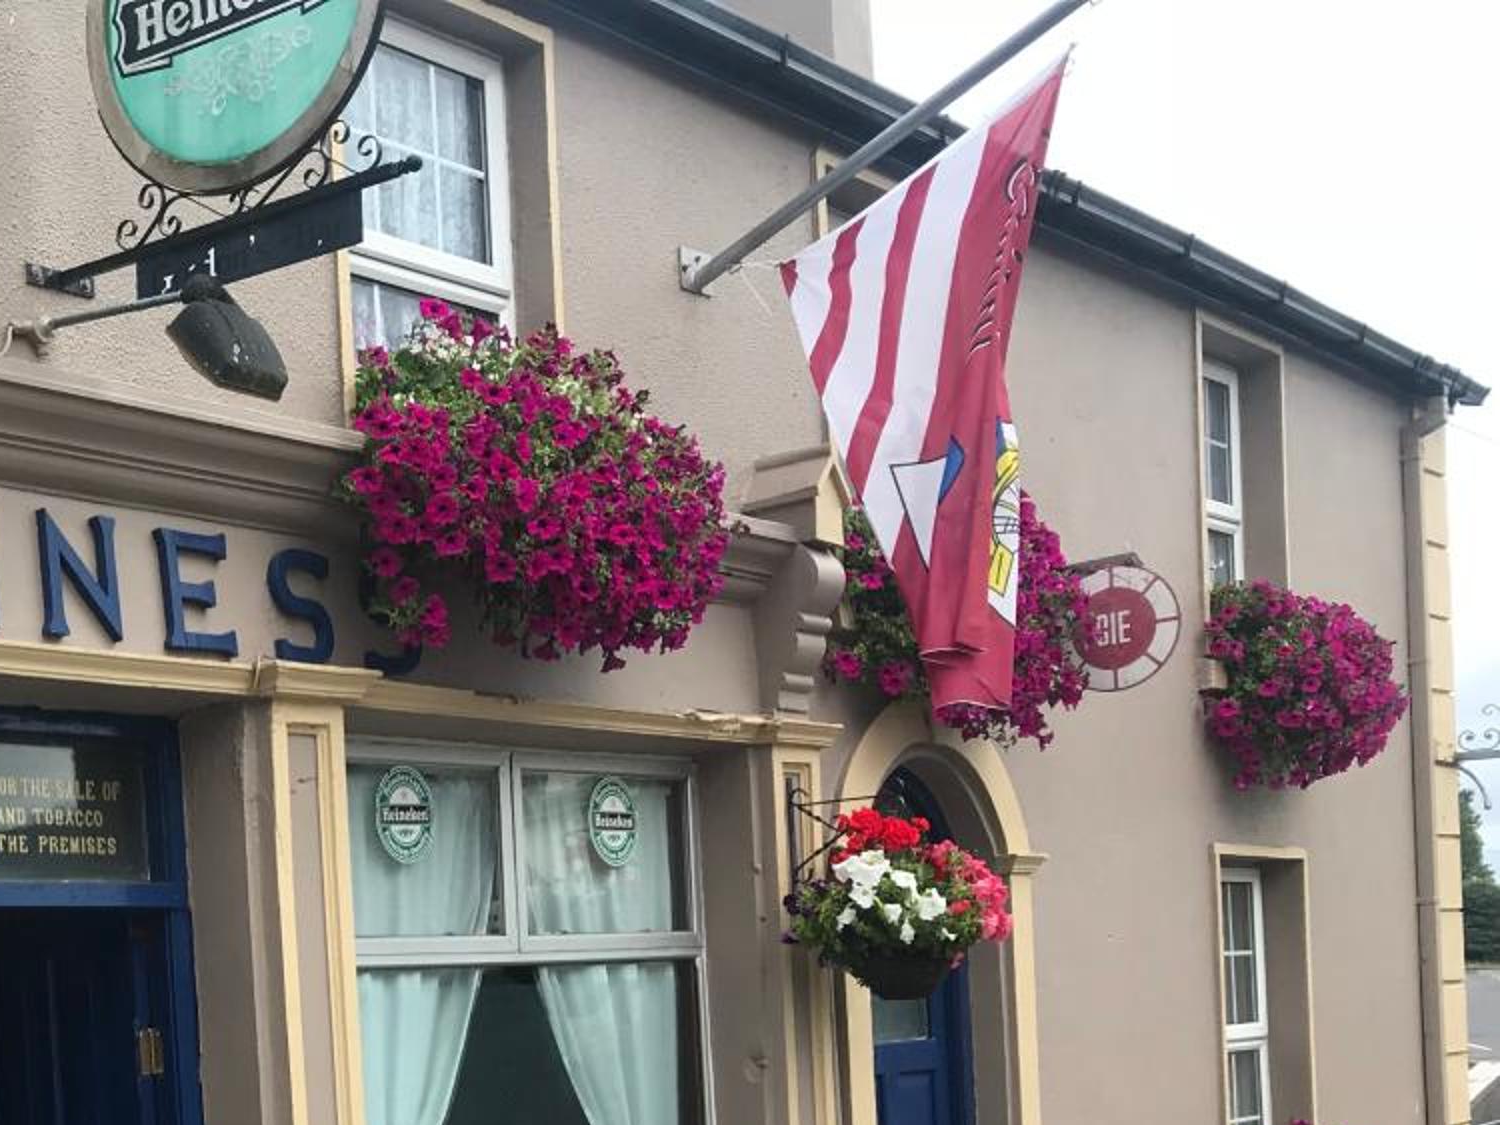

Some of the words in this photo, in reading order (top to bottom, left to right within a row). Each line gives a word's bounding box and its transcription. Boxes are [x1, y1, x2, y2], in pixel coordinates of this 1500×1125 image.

[134, 0, 270, 50] Hein
[20, 776, 51, 798] THE
[52, 777, 95, 801] SALE
[102, 780, 121, 801] OF
[32, 807, 104, 828] TOBACCO
[39, 835, 117, 855] PREMISES
